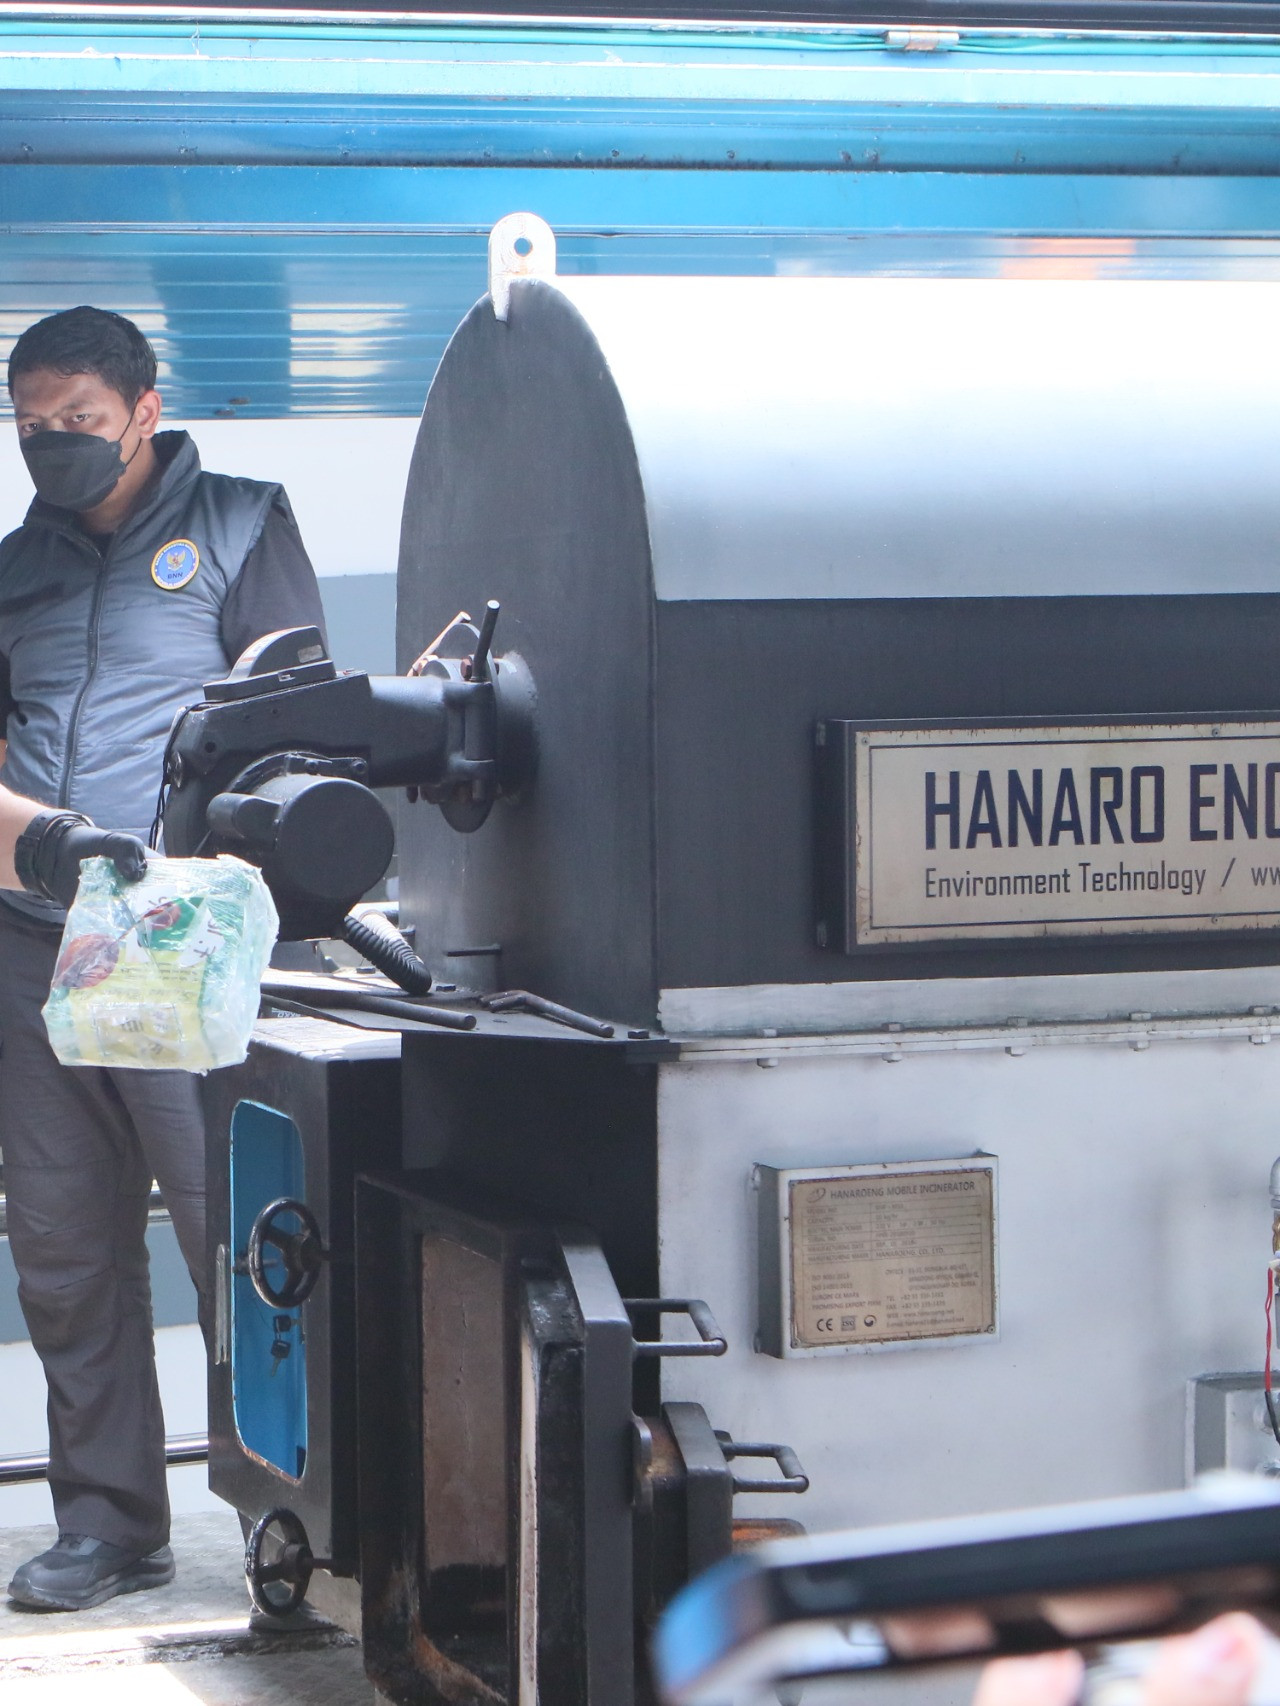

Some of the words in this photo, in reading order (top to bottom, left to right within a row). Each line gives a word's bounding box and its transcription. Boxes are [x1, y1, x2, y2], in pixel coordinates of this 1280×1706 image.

[167, 572, 183, 580] BNN
[925, 765, 1164, 851] HANARO
[925, 867, 1071, 898] Environment
[1078, 860, 1207, 896] Technology
[1221, 857, 1236, 888] /
[886, 1185, 918, 1196] MOBILE
[920, 1181, 975, 1195] INCINERATOR
